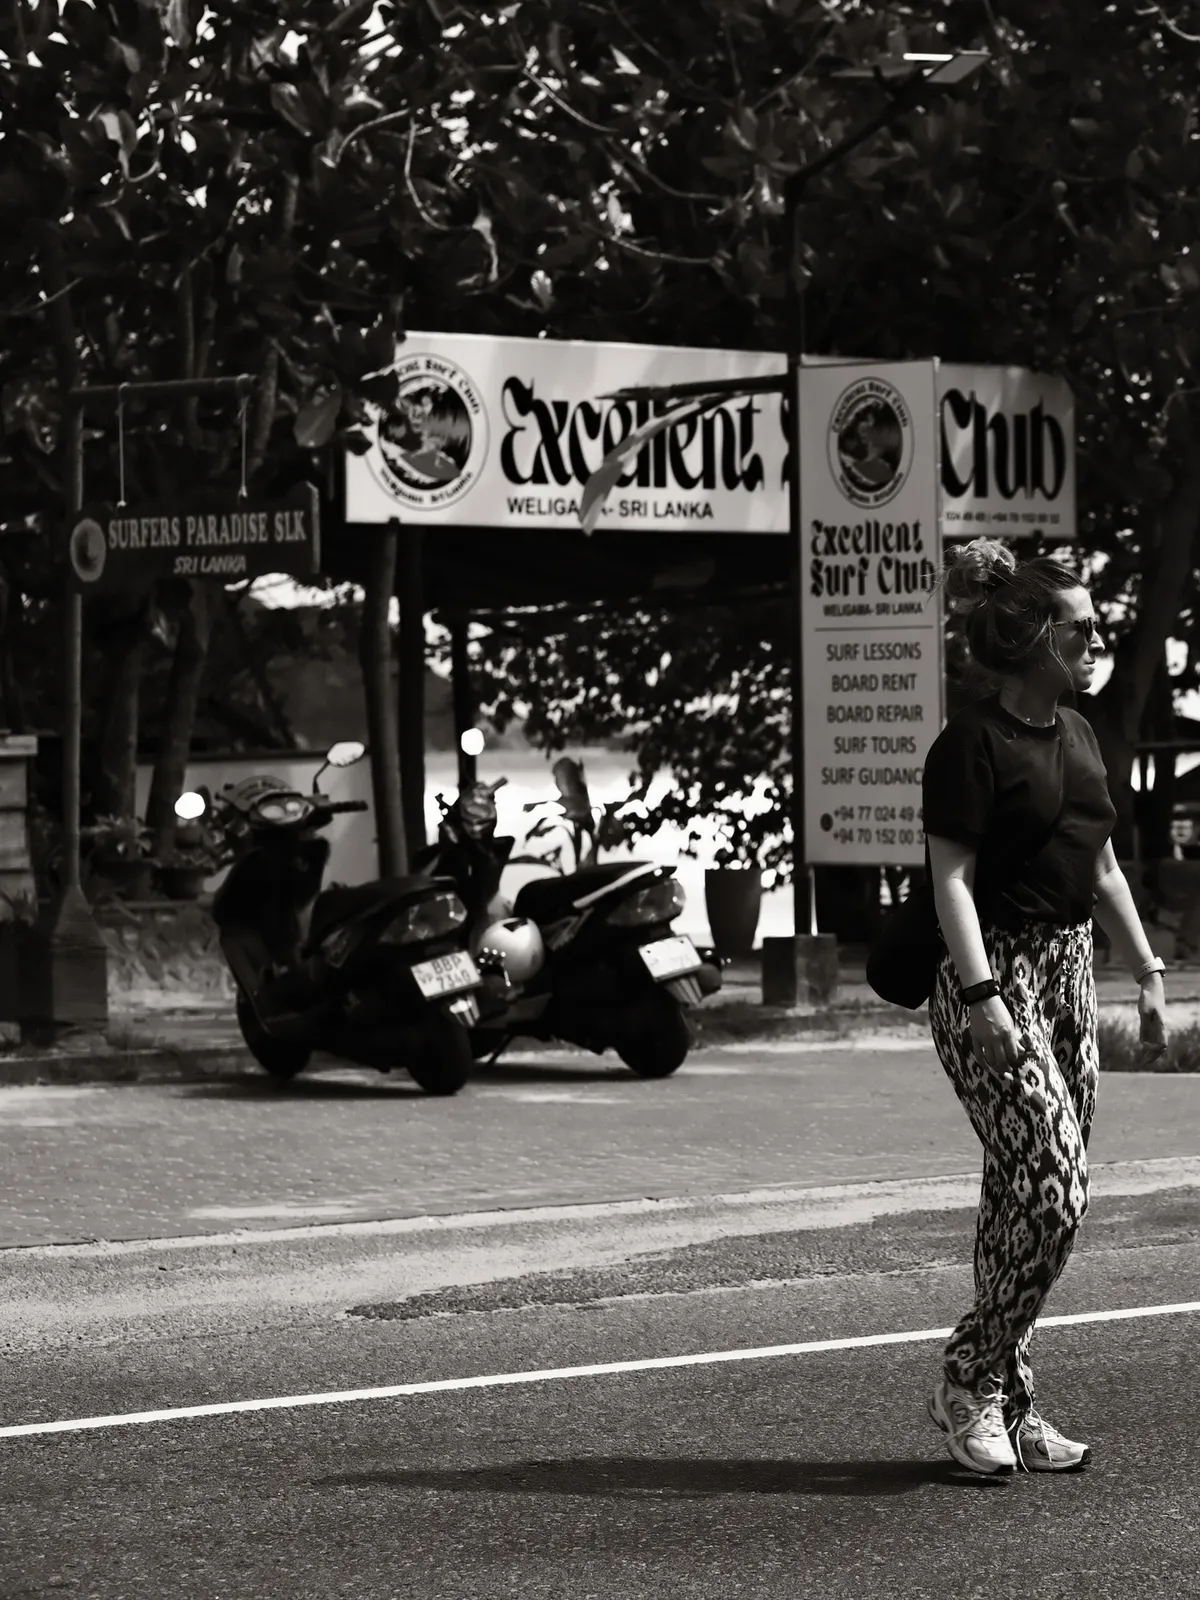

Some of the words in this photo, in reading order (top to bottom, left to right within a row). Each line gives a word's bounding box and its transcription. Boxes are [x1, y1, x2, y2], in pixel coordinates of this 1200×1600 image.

[939, 388, 1067, 501] Club
[619, 500, 648, 517] SRI
[653, 501, 714, 519] LANKA
[108, 516, 181, 549] SURFERS
[186, 512, 269, 546] PARADISE
[274, 510, 307, 542] SLK
[811, 519, 924, 556] Excellent
[173, 556, 197, 575] SRI
[200, 555, 247, 573] LANKA
[810, 556, 870, 598] Surf
[877, 555, 936, 596] Club
[875, 602, 891, 616] SRI
[892, 602, 923, 615] LANKA
[826, 643, 860, 662] SURF
[863, 642, 922, 661] LESSONS
[831, 674, 879, 692] BOARD
[882, 673, 918, 692] RENT
[827, 705, 873, 723] BOARD
[877, 704, 923, 723] REPAIR
[834, 736, 868, 754] SURF
[870, 735, 917, 754] TOURS
[821, 767, 855, 785] SURF
[858, 767, 924, 786] GUIDANC
[833, 805, 855, 822] +94
[857, 806, 872, 821] 77
[874, 806, 897, 822] 024
[899, 806, 915, 822] 49
[833, 828, 854, 845] +94
[857, 828, 872, 844] 70
[875, 829, 897, 845] 152
[898, 829, 914, 845] 00
